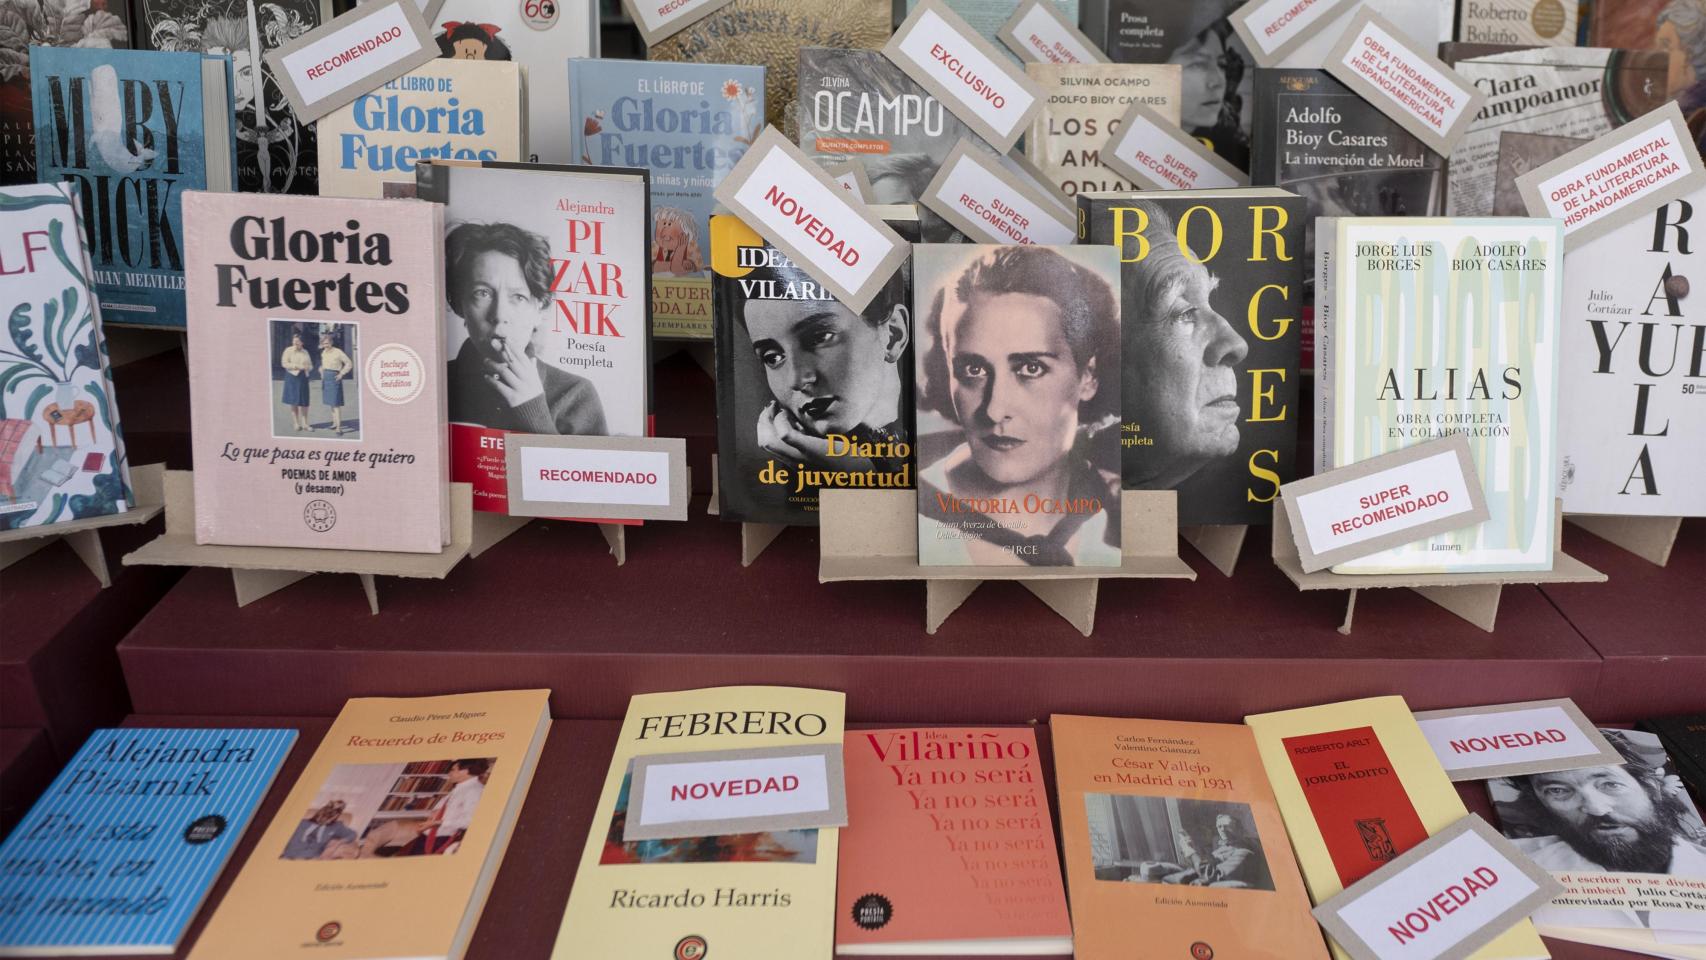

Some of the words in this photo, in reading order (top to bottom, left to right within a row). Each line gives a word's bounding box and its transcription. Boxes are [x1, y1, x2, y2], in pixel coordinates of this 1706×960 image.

[1121, 12, 1148, 23] Prosa
[1468, 1, 1528, 21] Roberto
[1120, 25, 1165, 39] completa
[1467, 24, 1519, 44] Bolaño
[306, 26, 402, 80] RECOMENDADO
[821, 76, 850, 88] SILVINA
[930, 43, 1005, 109] EXCLUSIVO
[1363, 36, 1390, 60] OBRA
[1391, 56, 1456, 109] FUNDAMENTAL
[385, 79, 398, 90] EL
[400, 77, 435, 92] LIBRO
[438, 78, 453, 92] DE
[638, 79, 651, 93] EL
[653, 76, 688, 94] LIBRO
[689, 81, 705, 95] DE
[1060, 77, 1101, 87] SILVINA
[1104, 77, 1150, 88] OCAMPO
[1362, 50, 1377, 64] DE
[1376, 60, 1389, 73] LA
[1390, 70, 1445, 115] LITERATURA
[1048, 95, 1088, 105] DOLFO
[1091, 95, 1116, 105] BIOY
[1350, 57, 1442, 128] HISPANOAMERICANA
[1472, 79, 1600, 123] ampoamor
[353, 94, 485, 136] Gloria
[611, 96, 733, 136] Gloria
[814, 90, 944, 136] OCAMPO
[1285, 107, 1341, 124] Adolfo
[47, 76, 184, 174] MBY
[1050, 118, 1097, 136] LOS
[1286, 129, 1322, 150] Bioy
[1328, 129, 1387, 147] Casares
[1163, 154, 1199, 181] SUPER
[1285, 152, 1300, 165] La
[1304, 152, 1364, 167] invención
[1368, 153, 1384, 166] de
[1387, 154, 1424, 168] Morel
[1551, 180, 1584, 202] OBRA
[1585, 137, 1670, 185] FUNDAMENTAL
[656, 174, 681, 186] niñas
[683, 179, 690, 188] y
[690, 175, 715, 188] niños
[1563, 198, 1581, 212] DE
[1583, 189, 1598, 202] LA
[1600, 153, 1669, 194] LITERATURA
[1564, 163, 1680, 227] HISPANOAMERICANA
[556, 198, 615, 216] Alejandra
[991, 198, 1029, 230] SUPER
[60, 173, 184, 271] DICK
[765, 185, 860, 267] NOVEDAD
[230, 215, 393, 266] Gloria
[565, 218, 607, 255] PI
[1355, 244, 1399, 258] JORGE
[1403, 245, 1433, 257] LUIS
[1473, 244, 1527, 258] ADOLFO
[1367, 258, 1421, 271] BORGES
[1452, 259, 1484, 271] BIOY
[1487, 259, 1547, 272] CASARES
[125, 272, 185, 290] MELVILLE
[549, 258, 629, 299] ZAR
[214, 264, 410, 314] Fuertes
[1588, 289, 1613, 302] Julio
[552, 299, 626, 338] NIK
[686, 302, 707, 316] LA
[1587, 302, 1633, 316] Cortázar
[567, 337, 606, 354] Poesía
[559, 354, 614, 370] completa
[381, 370, 410, 379] poemas
[1376, 366, 1522, 401] ALIAS
[1681, 384, 1695, 394] 50
[1396, 412, 1432, 425] OBRA
[1436, 412, 1503, 425] COMPLETA
[1388, 427, 1405, 438] EN
[1409, 423, 1511, 438] COLABORACIÓN
[826, 433, 910, 458] Diario
[221, 442, 241, 462] Lo
[243, 447, 269, 463] que
[269, 446, 305, 464] pasa
[308, 449, 321, 460] es
[323, 450, 351, 466] que
[353, 449, 366, 462] te
[368, 447, 415, 469] quiero
[281, 469, 317, 481] POEMAS
[319, 469, 330, 481] DE
[332, 470, 357, 482] AMOR
[540, 468, 657, 485] RECOMENDADO
[758, 460, 789, 484] de
[795, 463, 910, 493] juventud
[294, 483, 304, 495] (y
[305, 483, 344, 496] desamor)
[1359, 484, 1411, 509] SUPER
[935, 492, 1020, 514] VICTORIA
[1023, 493, 1102, 514] OCAMPO
[1331, 490, 1449, 536] RECOMENDADO
[986, 520, 996, 529] de
[1003, 545, 1040, 555] CIRCE
[1431, 542, 1462, 552] Lumen
[389, 714, 426, 723] Claudio
[635, 710, 827, 740] FEBRERO
[347, 733, 424, 748] Recuerdo
[427, 732, 448, 745] de
[452, 730, 506, 746] Borges
[925, 731, 948, 740] Idea
[1117, 735, 1146, 743] Carlos
[1147, 736, 1195, 746] Fernández
[1450, 729, 1567, 754] NOVEDAD
[83, 739, 256, 771] Alejandra
[866, 731, 1030, 762] Vilariño
[1114, 743, 1158, 753] Valentino
[1160, 745, 1201, 755] Gianuzzi
[1294, 741, 1345, 755] ROBERTO
[1346, 737, 1372, 748] ARLT
[890, 764, 922, 786] Ya
[931, 770, 966, 785] no
[974, 763, 1035, 785] será
[1112, 757, 1154, 769] César
[1158, 760, 1211, 776] Vallejo
[1333, 761, 1350, 770] EL
[57, 768, 218, 798] Pizarnik
[1093, 774, 1111, 783] en
[1117, 772, 1174, 787] Madrid
[1178, 778, 1197, 788] en
[1202, 778, 1234, 791] 1931
[1304, 767, 1389, 787] JOROBADITO
[671, 775, 799, 801] NOVEDAD
[907, 789, 938, 811] Ya
[945, 796, 977, 809] no
[984, 788, 1039, 809] será
[1561, 875, 1572, 883] el
[1577, 875, 1620, 884] escritor
[1666, 878, 1706, 889] diviert
[609, 889, 706, 909] Ricardo
[713, 888, 792, 908] Harris
[1154, 896, 1183, 905] Edición
[1582, 887, 1627, 895] imbécil
[1636, 888, 1667, 897] Julio
[1388, 866, 1498, 945] NOVEDAD
[1552, 897, 1625, 906] entrevistado
[1629, 900, 1648, 908] por
[1652, 899, 1682, 909] Rosa
[1685, 901, 1706, 910] Per
